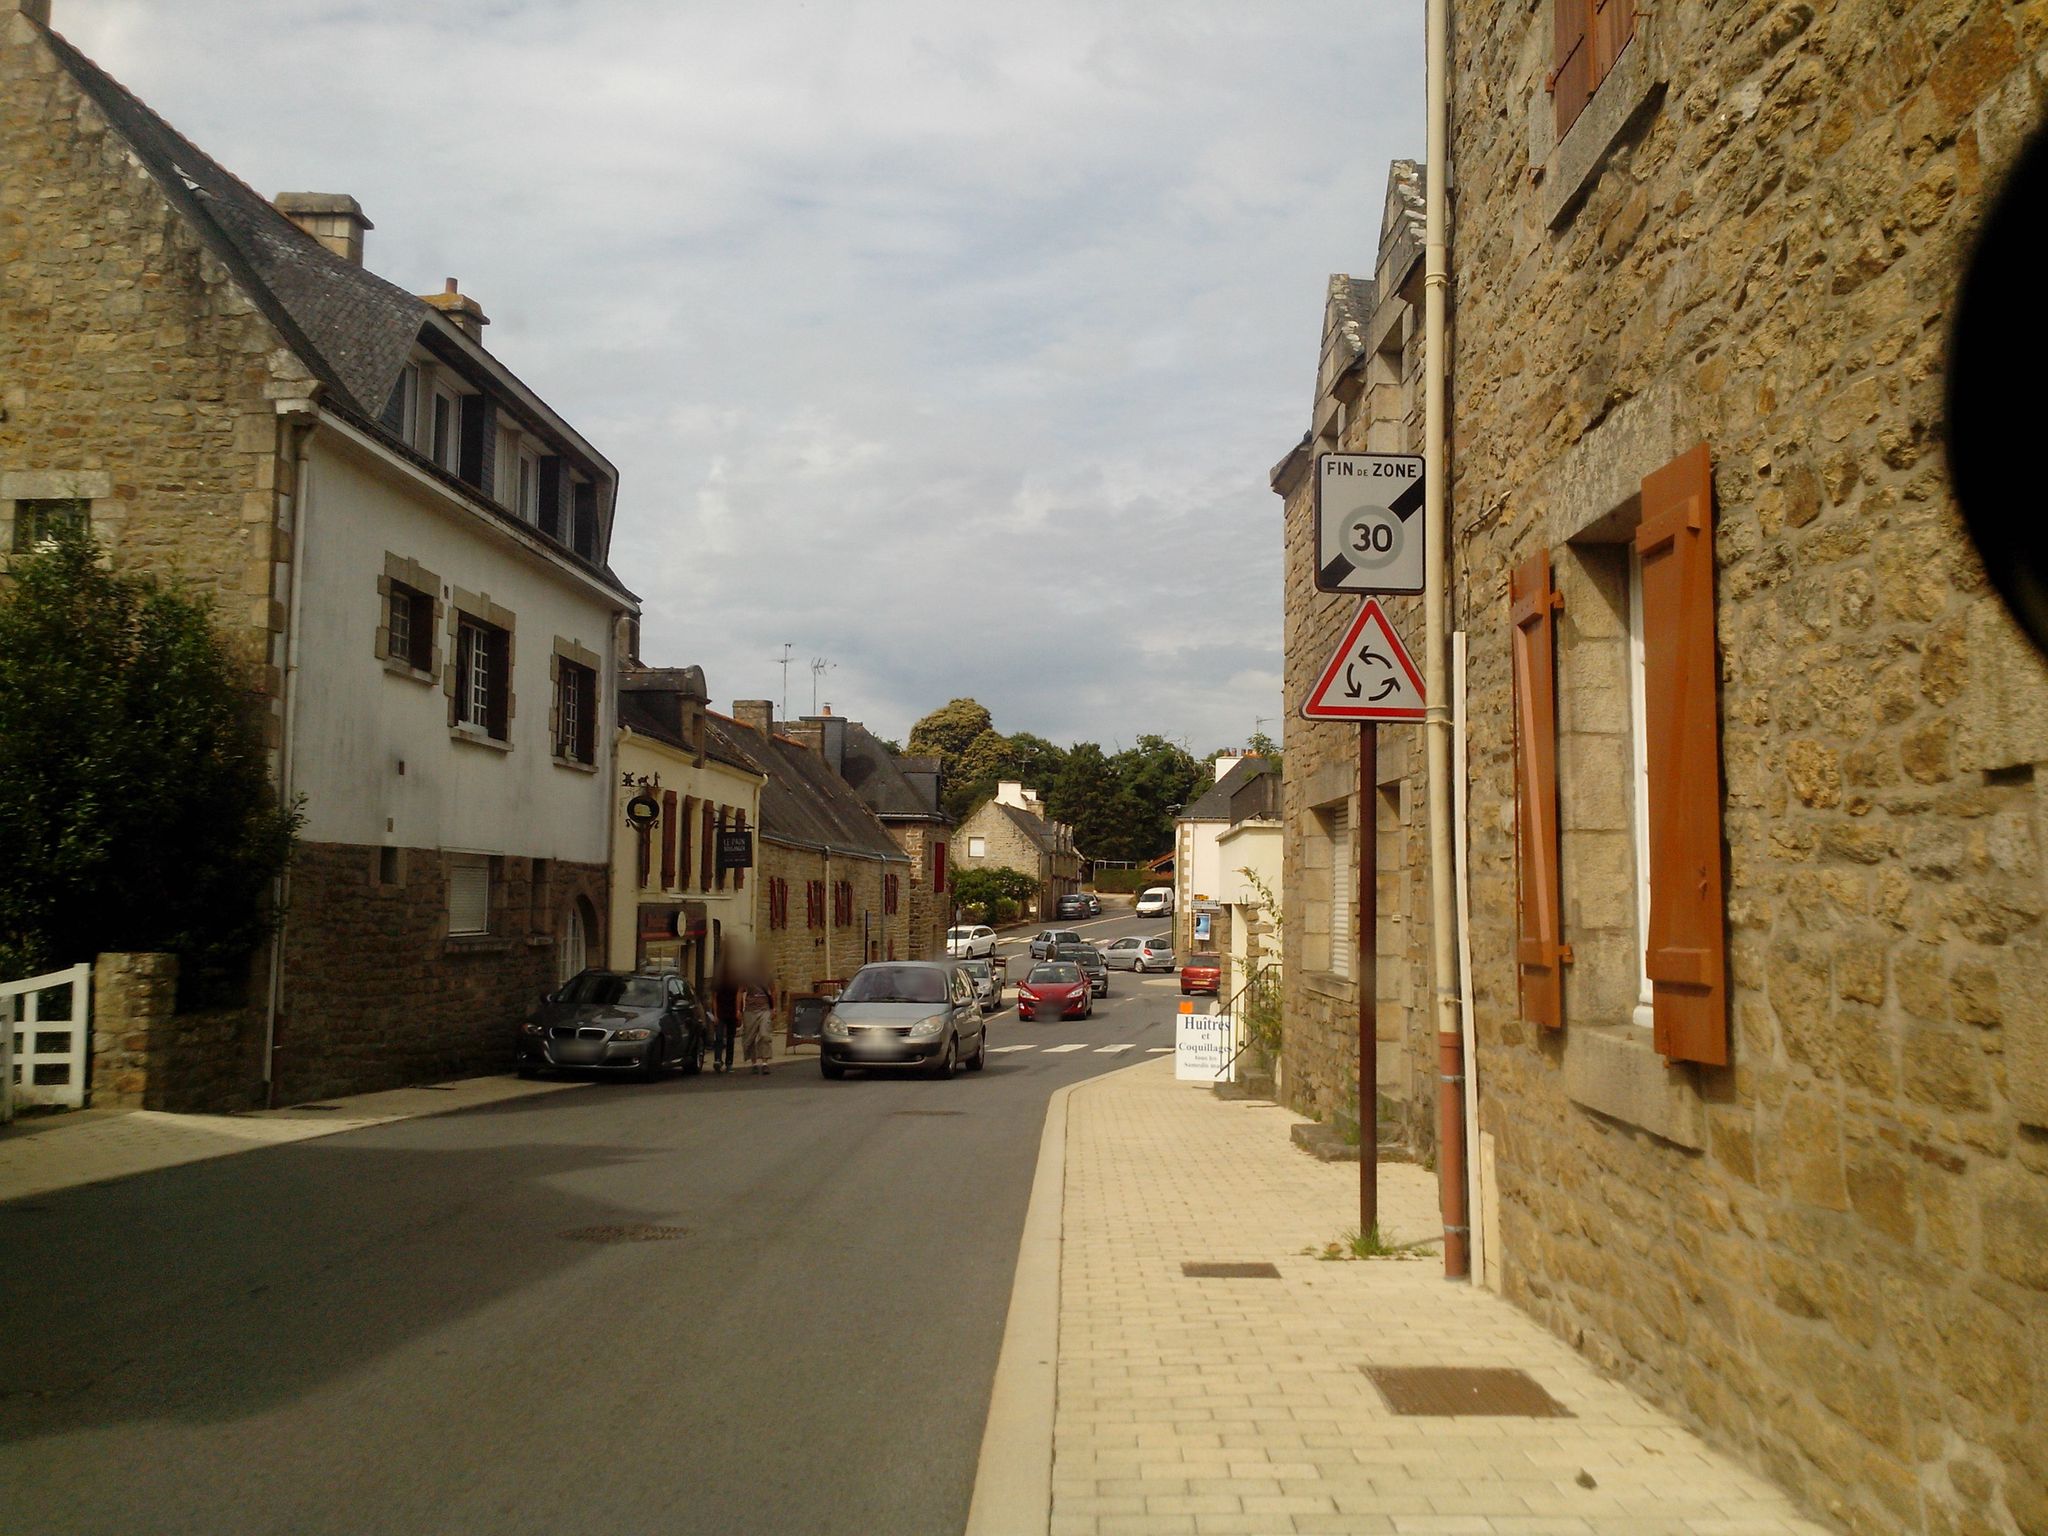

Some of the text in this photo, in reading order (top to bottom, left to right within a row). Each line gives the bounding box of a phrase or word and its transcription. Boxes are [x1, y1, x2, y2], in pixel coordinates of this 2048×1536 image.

[1327, 461, 1417, 478] FIN DE ZONE
[1352, 523, 1393, 552] 30
[1184, 1016, 1231, 1031] Huîtres
[1201, 1032, 1210, 1040] et
[1178, 1042, 1232, 1054] Coquillages
